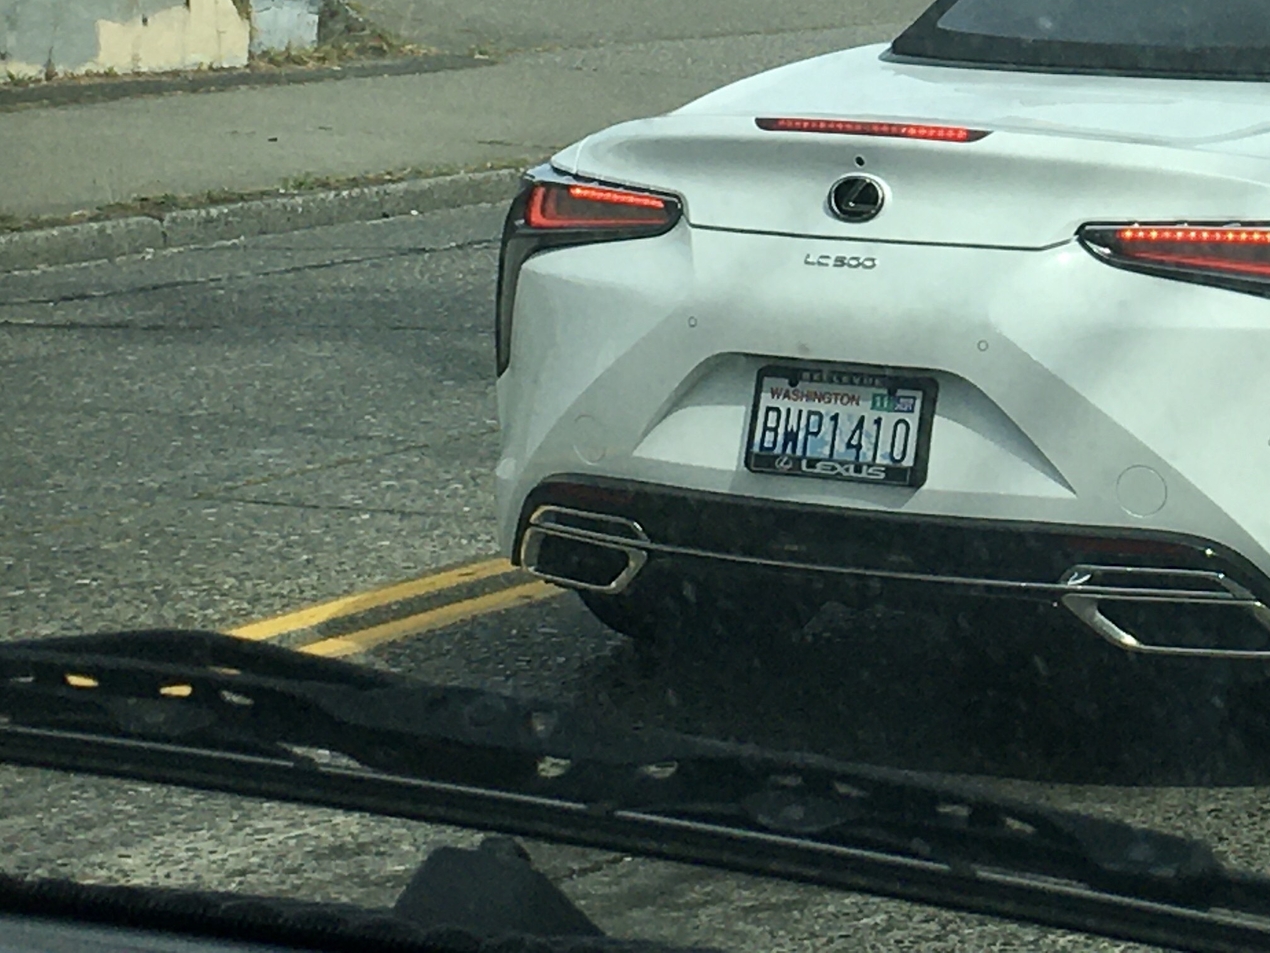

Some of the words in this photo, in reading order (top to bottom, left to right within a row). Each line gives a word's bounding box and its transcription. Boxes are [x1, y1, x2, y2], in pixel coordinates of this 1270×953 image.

[770, 387, 860, 406] WASHINGTON
[758, 406, 911, 464] BWP1410
[801, 458, 886, 479] LEXUS
